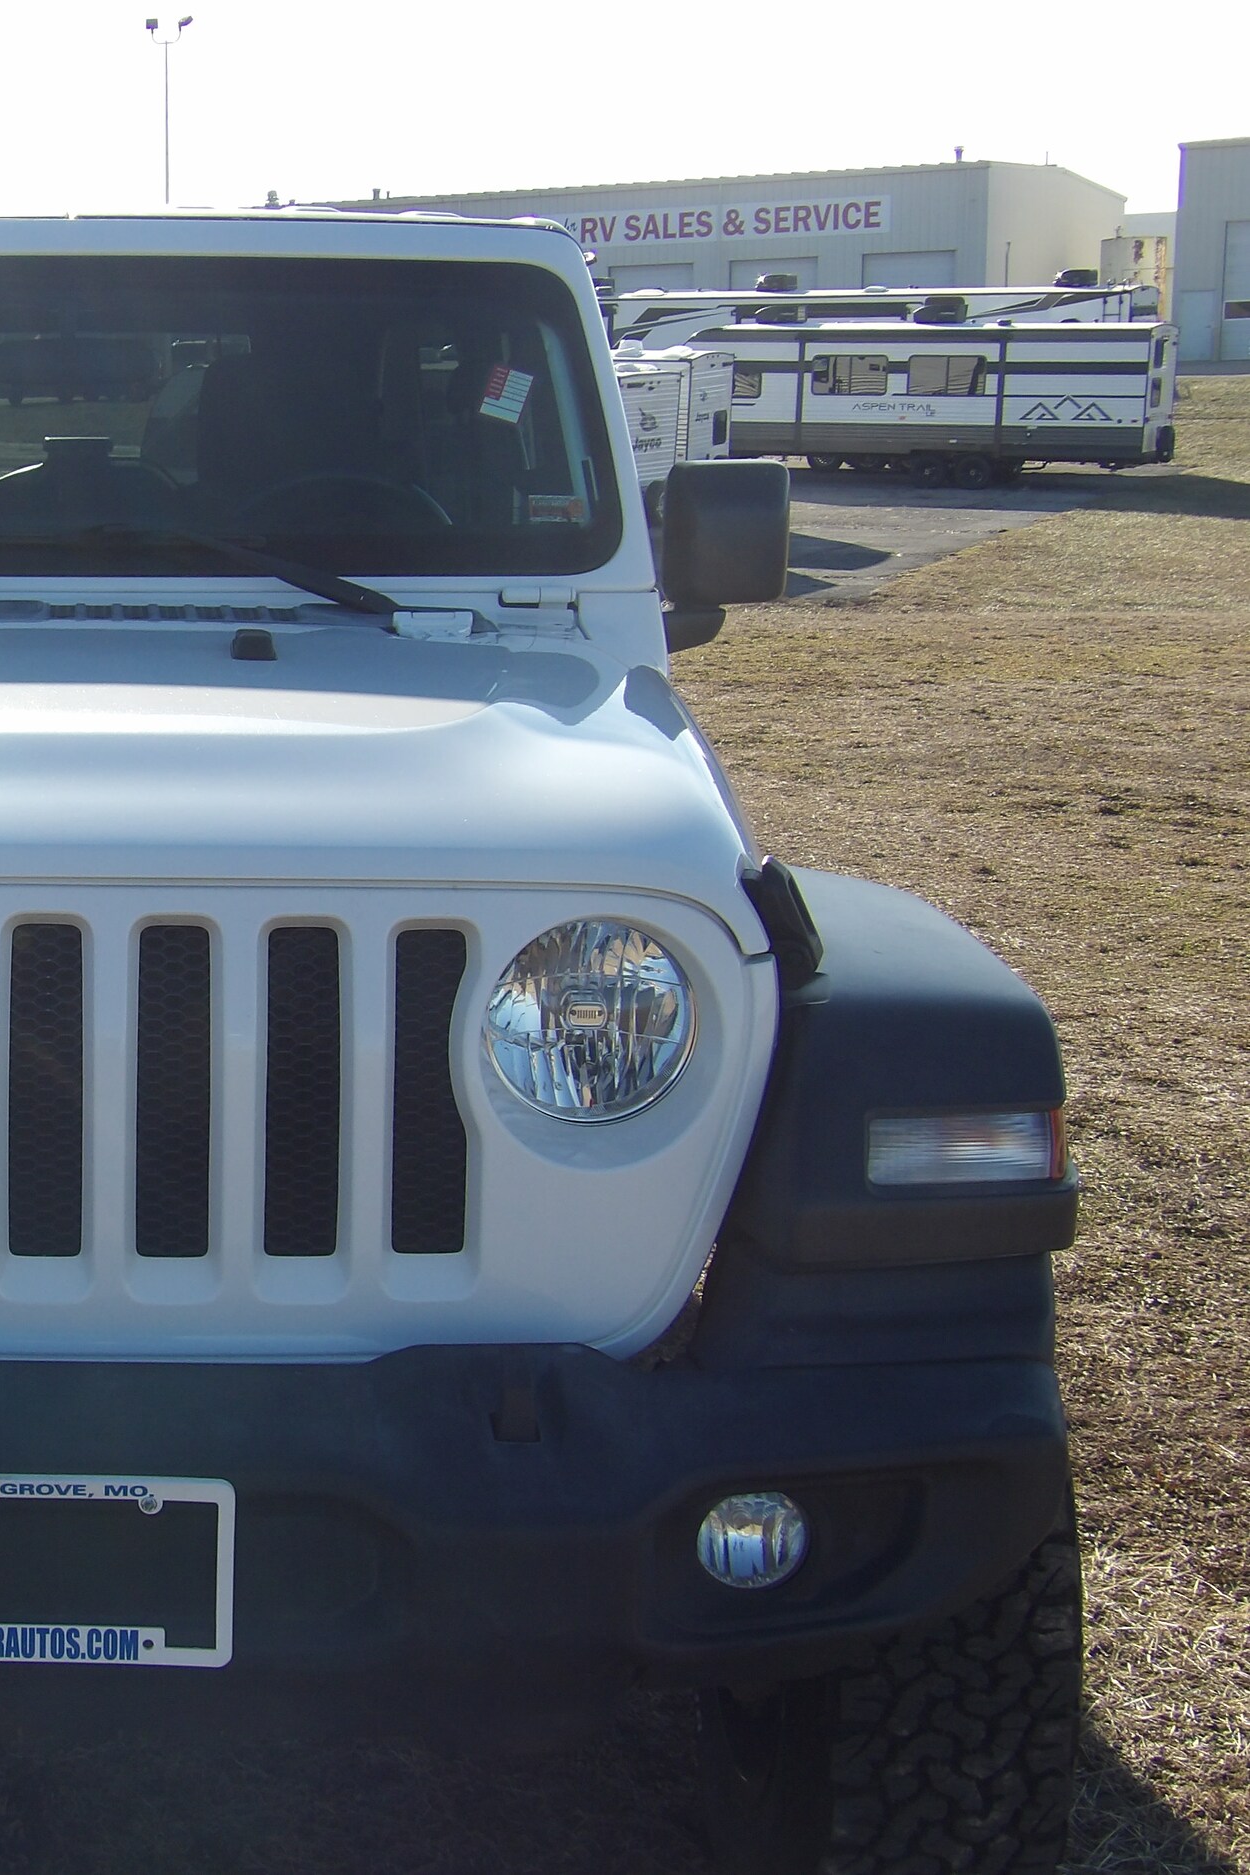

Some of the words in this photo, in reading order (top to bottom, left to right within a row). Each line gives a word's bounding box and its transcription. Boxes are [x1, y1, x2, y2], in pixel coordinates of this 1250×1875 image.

[580, 216, 617, 243] RV
[623, 210, 714, 242] SALES
[722, 208, 745, 236] &
[753, 201, 882, 235] SERVICE
[852, 402, 896, 411] ASPEN
[898, 402, 936, 411] TRAIL
[632, 437, 662, 453] Jayco
[0, 1482, 95, 1499] GROVE,
[104, 1484, 155, 1498] MO.
